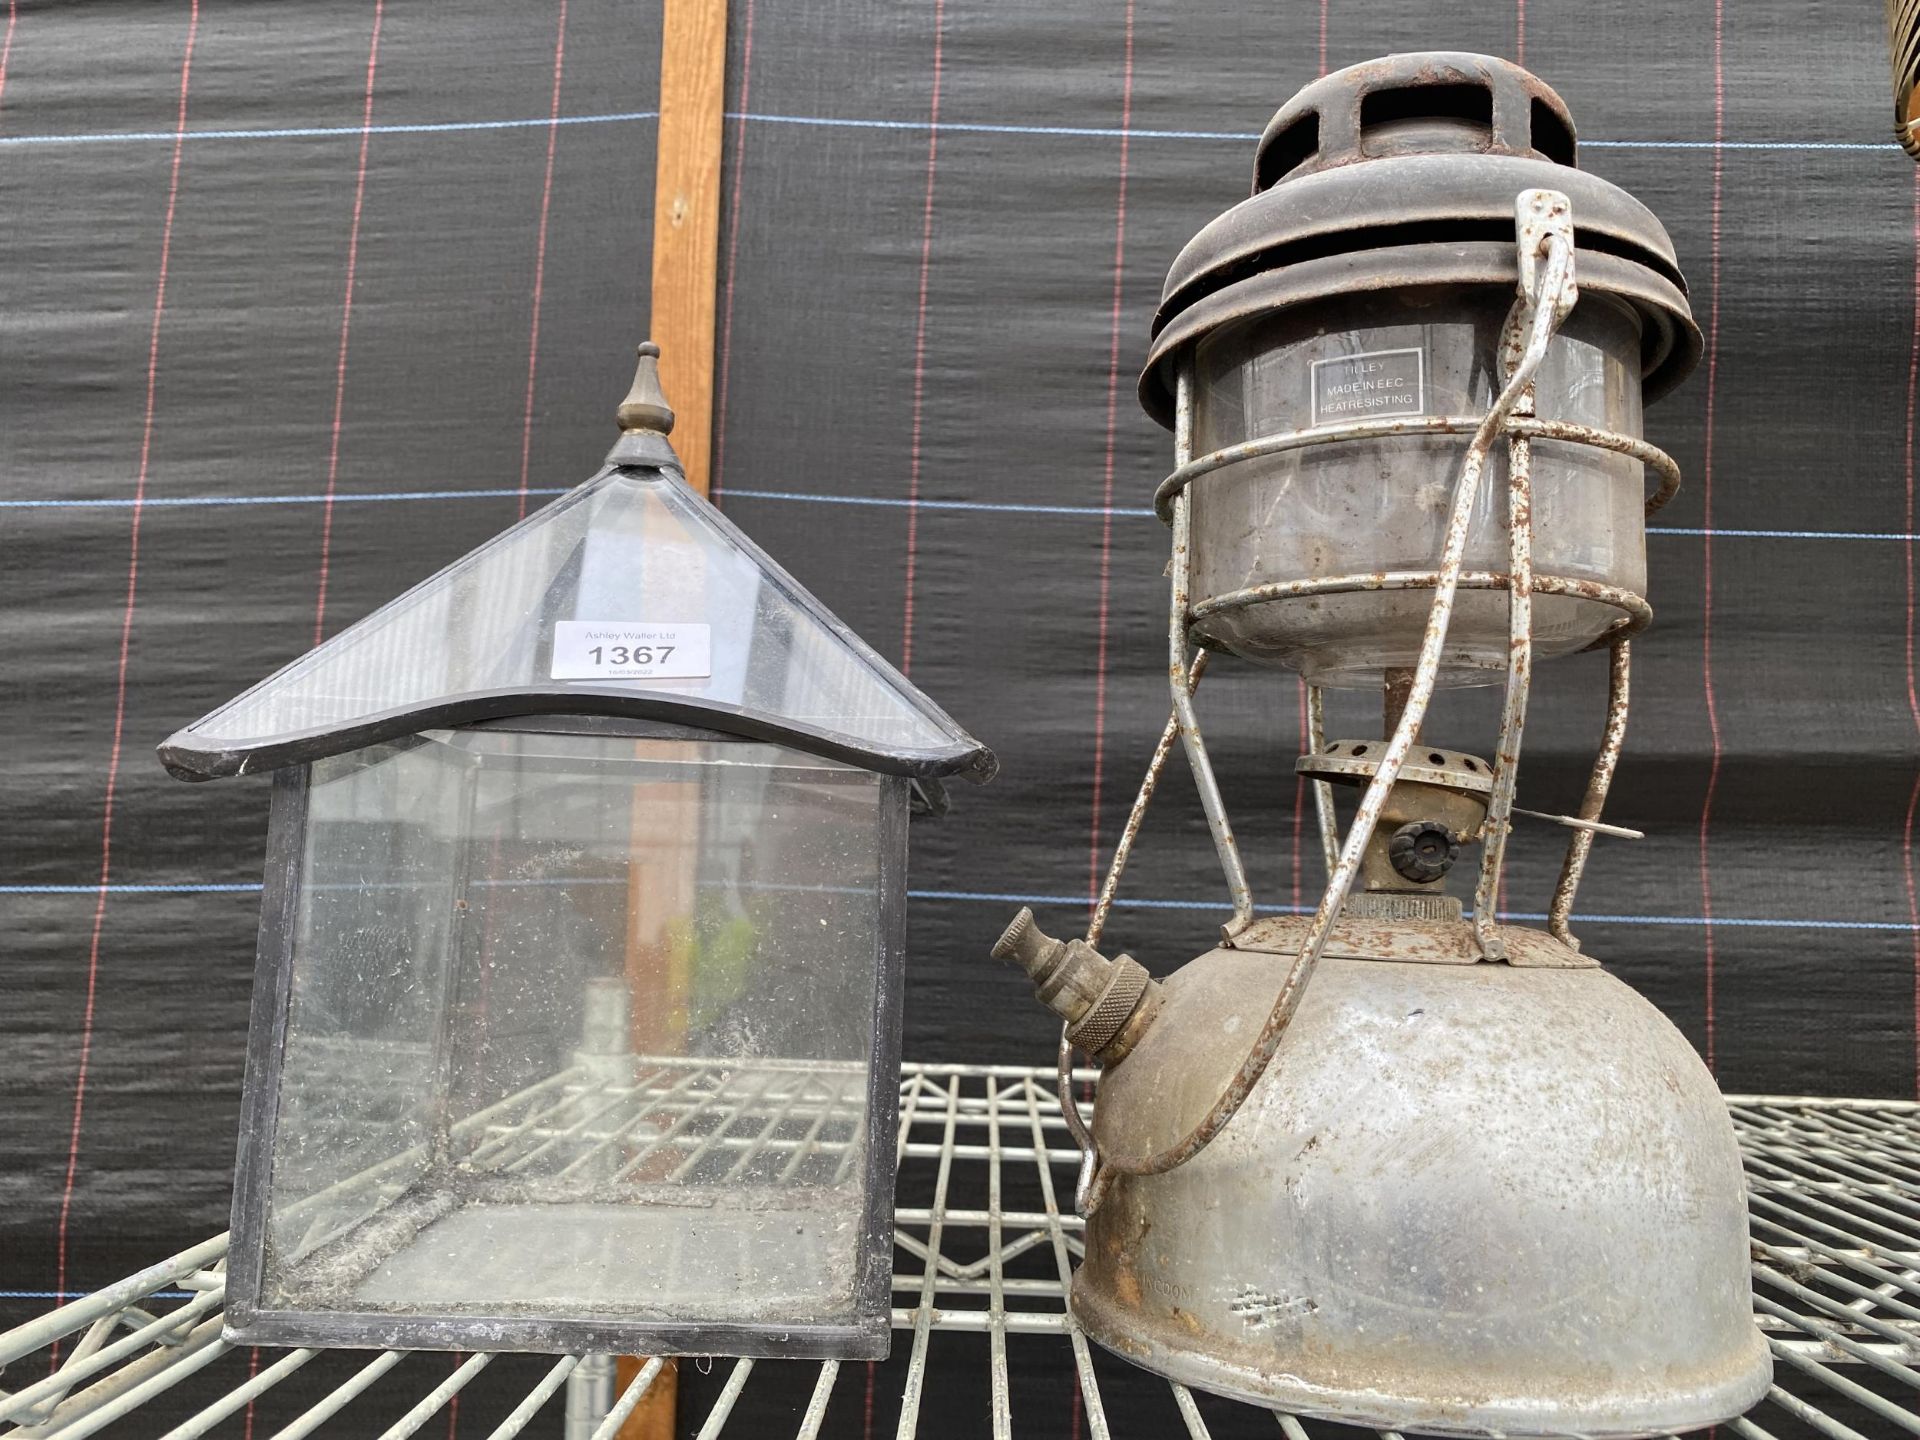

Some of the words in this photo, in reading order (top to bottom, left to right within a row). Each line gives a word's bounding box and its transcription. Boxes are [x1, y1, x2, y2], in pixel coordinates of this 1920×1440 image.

[1344, 362, 1385, 376] TILLEY
[1327, 382, 1360, 396] MADE
[1362, 381, 1374, 391] IN
[1377, 377, 1404, 389] EEC
[585, 631, 621, 640] Ashley
[624, 632, 657, 640] Waller
[659, 632, 676, 640] Ltd
[588, 646, 676, 665] 1367
